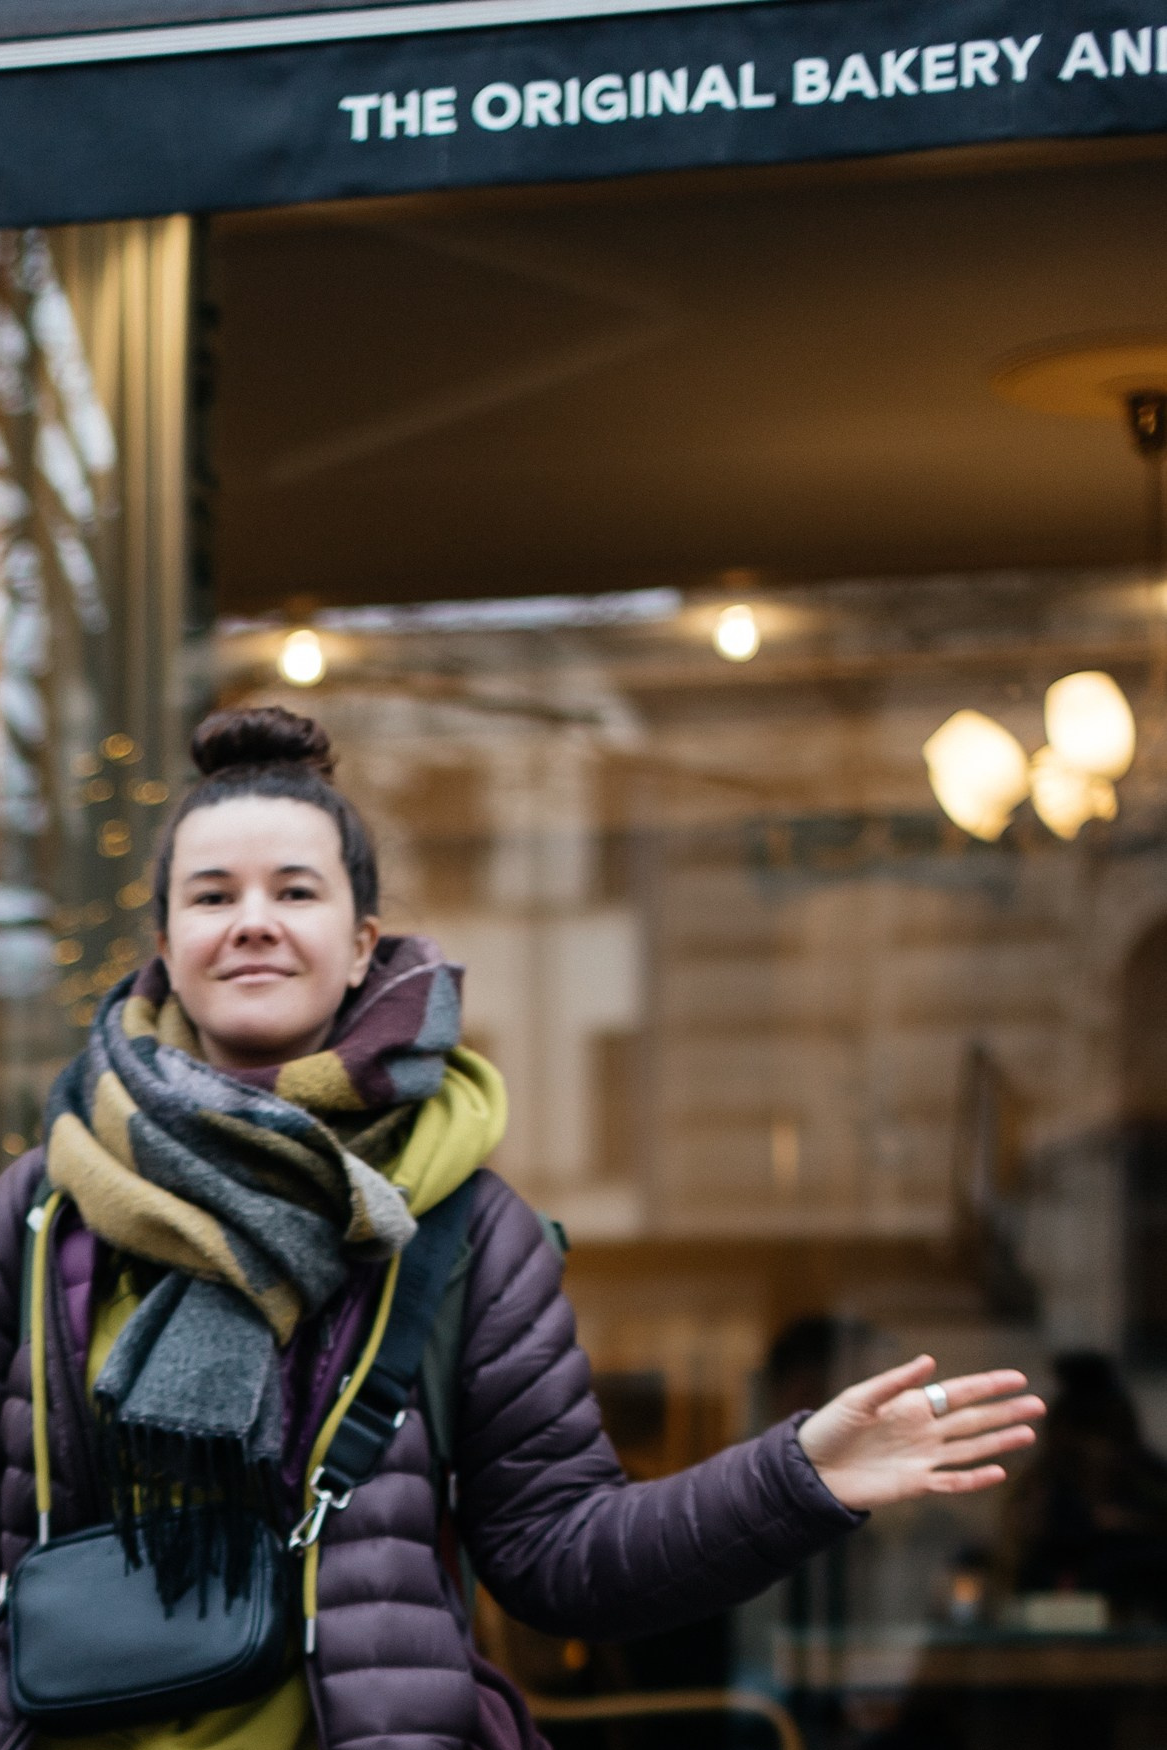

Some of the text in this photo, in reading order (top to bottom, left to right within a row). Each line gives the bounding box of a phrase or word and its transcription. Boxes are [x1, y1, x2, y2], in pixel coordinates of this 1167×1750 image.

[338, 86, 458, 142] THE
[471, 62, 776, 132] ORIGINAL
[792, 34, 1042, 105] BAKERY
